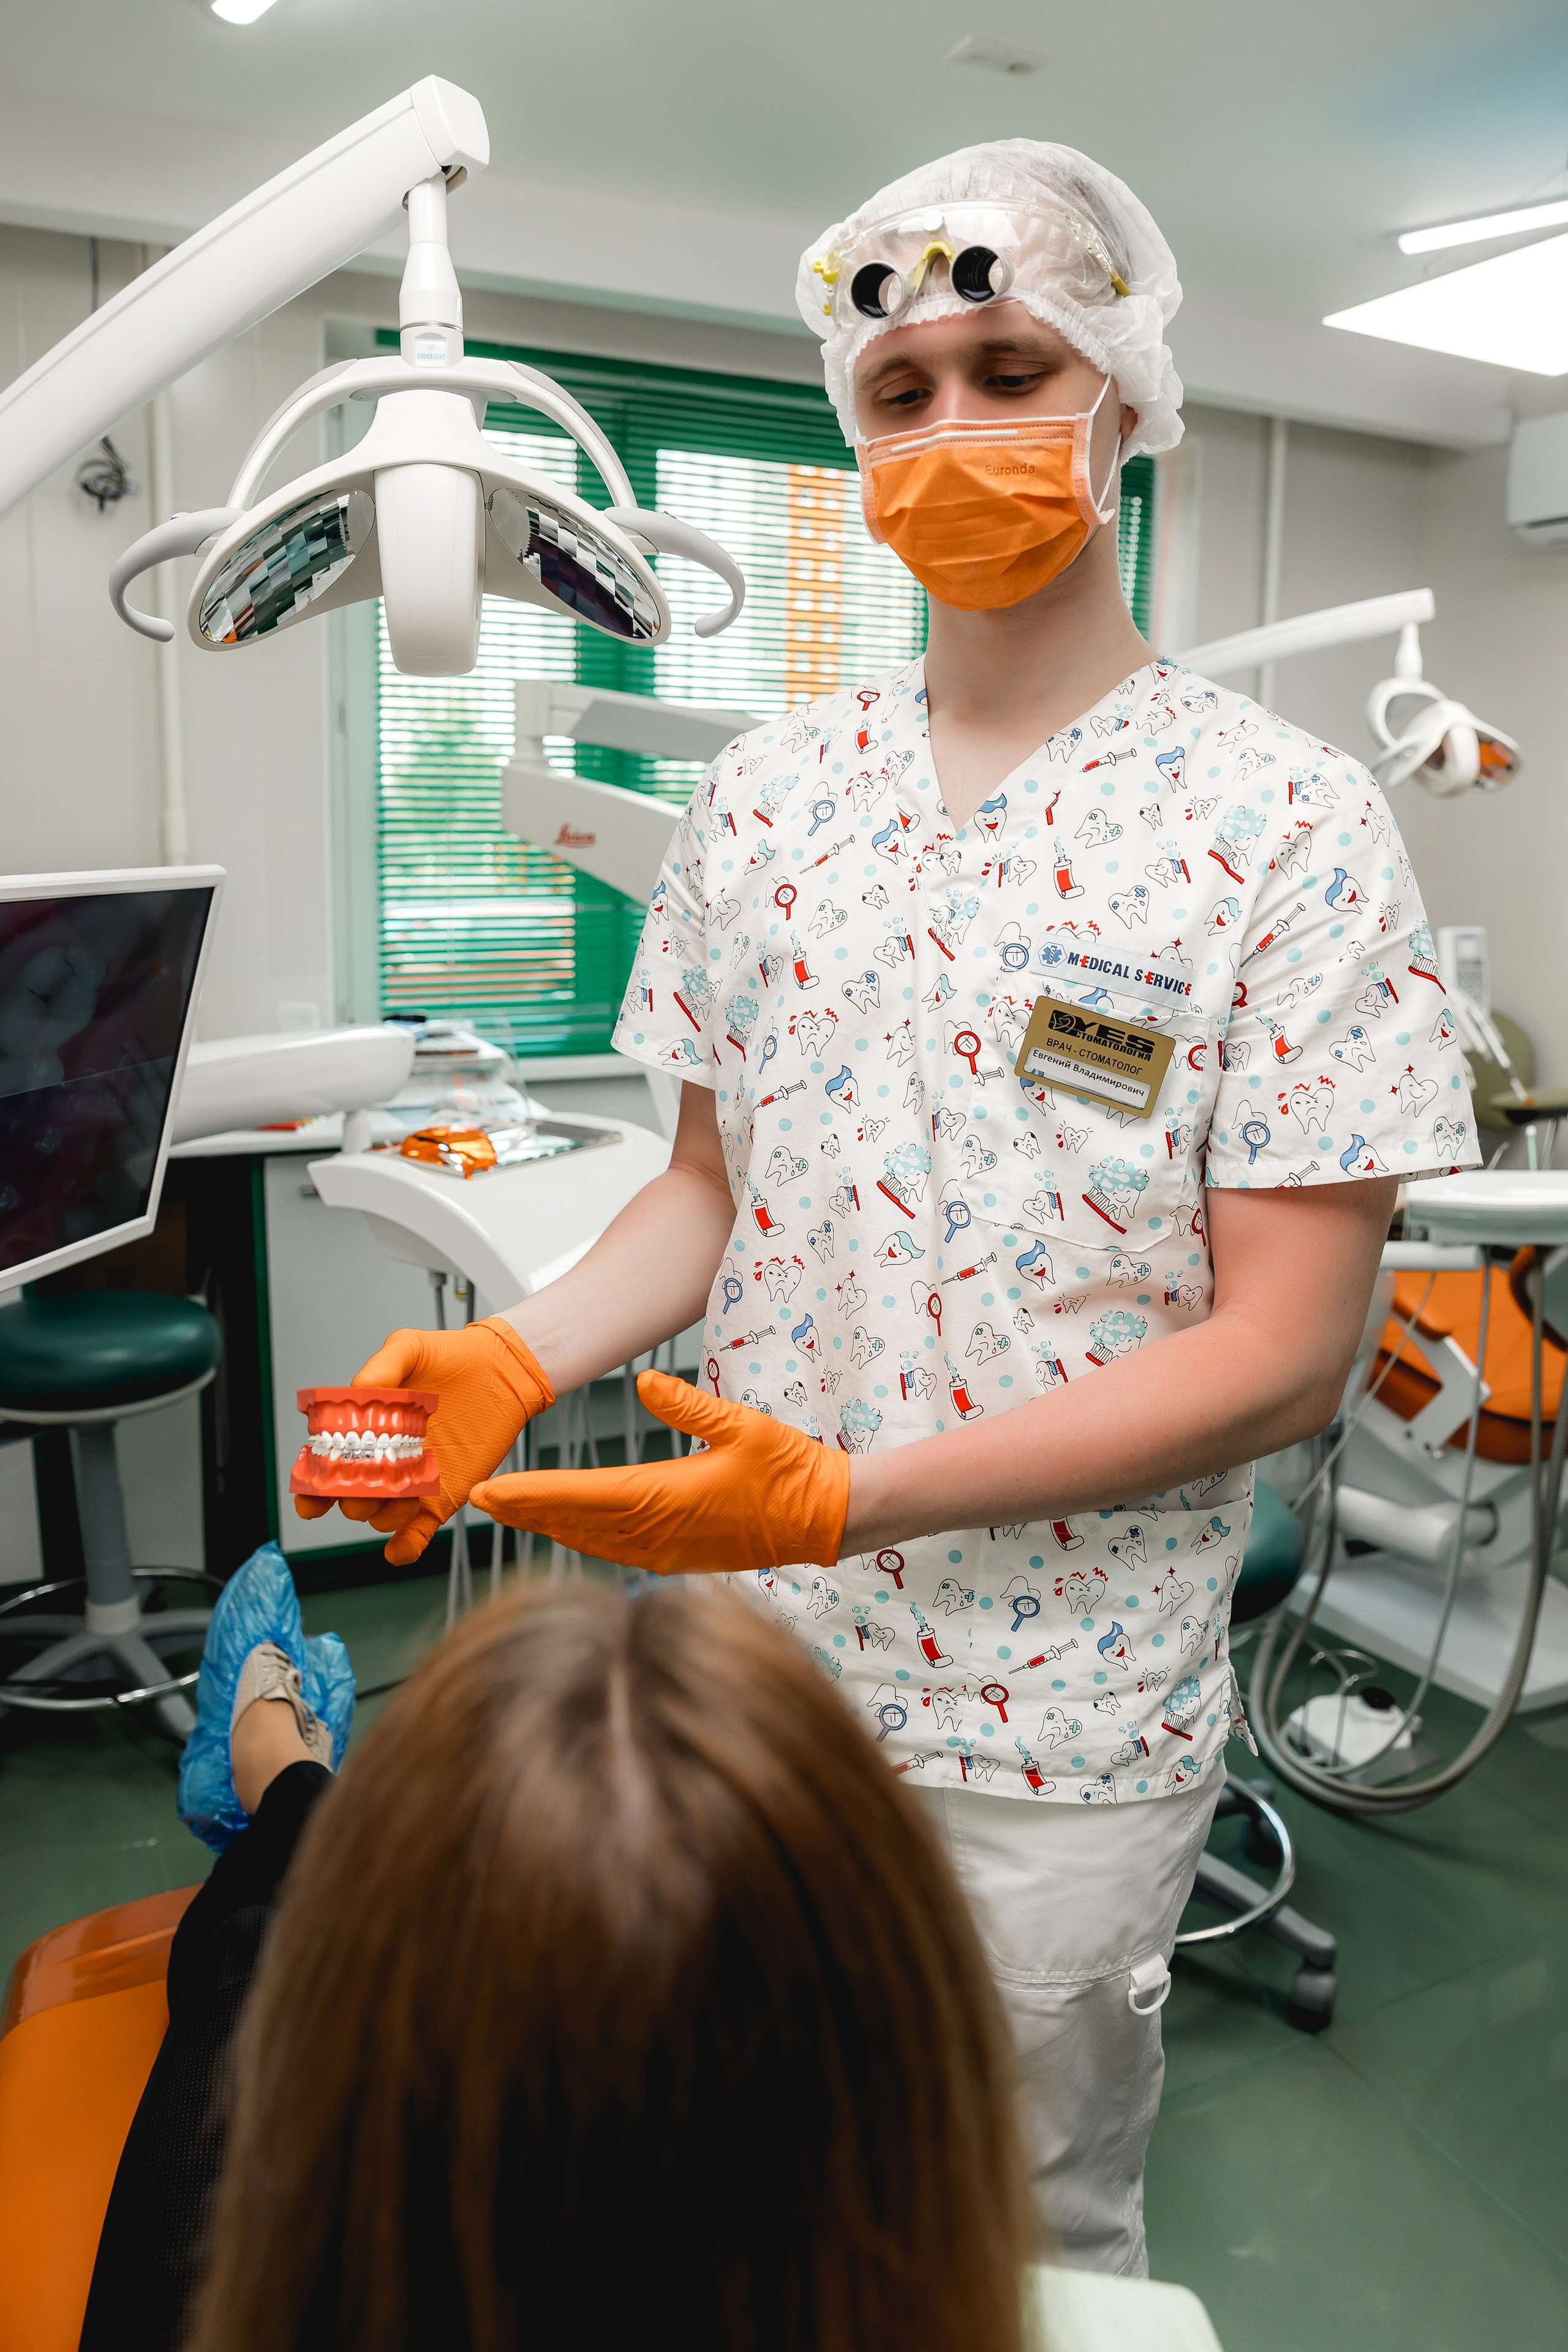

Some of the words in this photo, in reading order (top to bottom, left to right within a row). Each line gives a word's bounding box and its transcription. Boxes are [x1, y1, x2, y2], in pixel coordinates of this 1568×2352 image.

[985, 463, 1035, 475] Euronda
[1067, 952, 1129, 979] MEDICAL
[1134, 969, 1192, 996] SERVICE
[1073, 1016, 1155, 1054] YES
[1076, 1031, 1152, 1061] СТОМАТОЛОГИЯ
[1033, 1049, 1071, 1069] Евгений
[1072, 1064, 1145, 1097] Владимирович
[1046, 1038, 1071, 1052] ВРАЧ
[1079, 1048, 1144, 1076] СТОМАТОЛОГ
